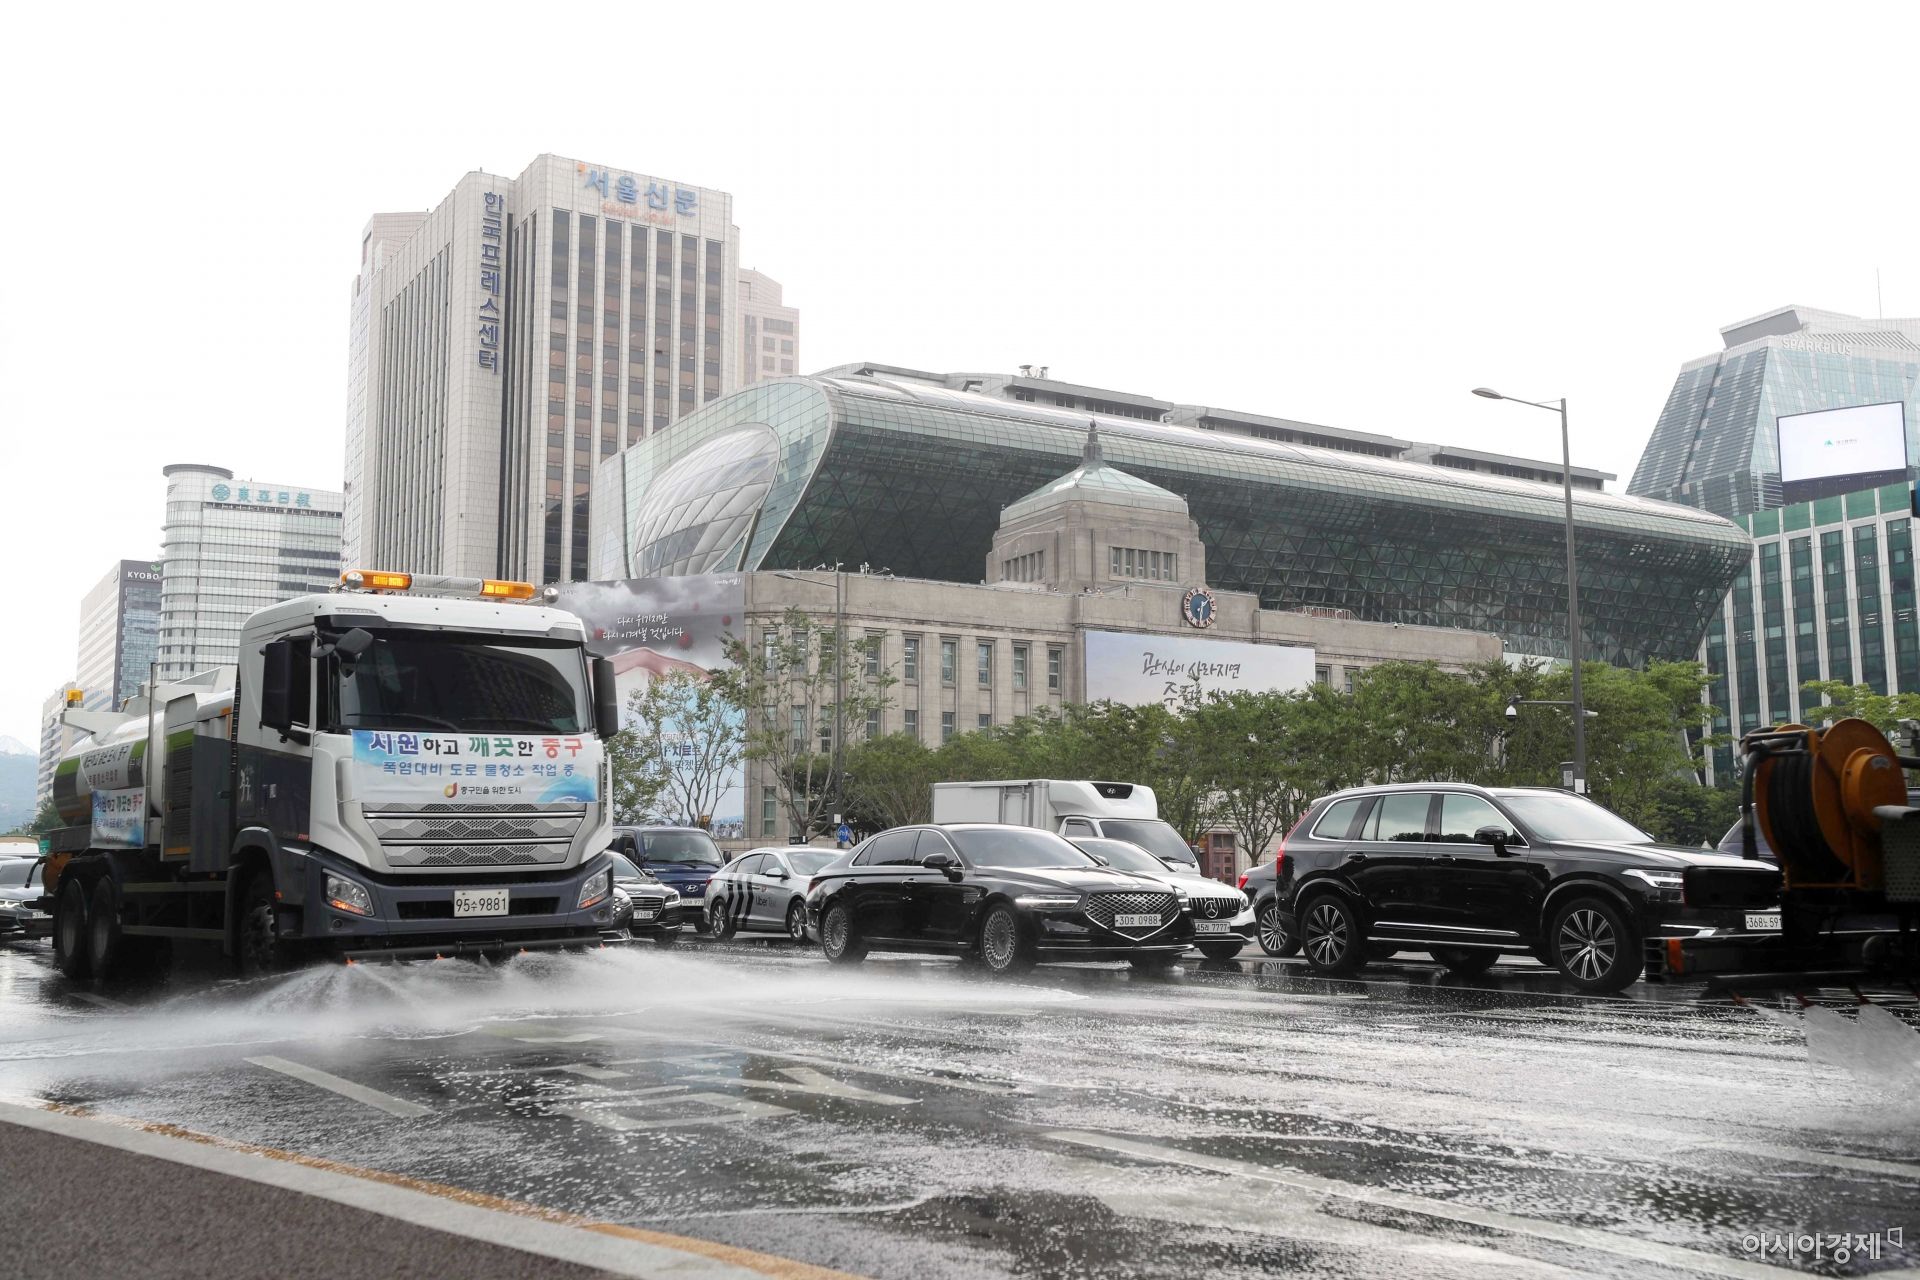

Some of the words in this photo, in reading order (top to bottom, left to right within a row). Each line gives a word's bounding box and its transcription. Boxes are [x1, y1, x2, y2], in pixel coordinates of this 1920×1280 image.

[584, 169, 698, 217] 서울신문
[127, 571, 159, 580] KYOBO
[617, 616, 634, 626] 다시
[602, 631, 619, 640] 다시
[650, 627, 684, 641] 것입니다
[1143, 652, 1185, 676] 관심이
[1188, 661, 1241, 679] 사라지면
[370, 732, 460, 755] 시원하고
[468, 737, 534, 757] 깨끗한
[541, 738, 583, 758] 중구
[384, 761, 443, 776] 폭염대비
[450, 763, 478, 776] 도로
[485, 764, 525, 777] 물청소
[532, 764, 558, 776] 작업
[564, 764, 575, 777] 중
[461, 786, 490, 795] 중구민을
[492, 786, 506, 794] 위한
[508, 786, 521, 794] 도시
[456, 897, 506, 912] 95수9881
[755, 897, 768, 907] Uber
[1138, 915, 1158, 925] 0988
